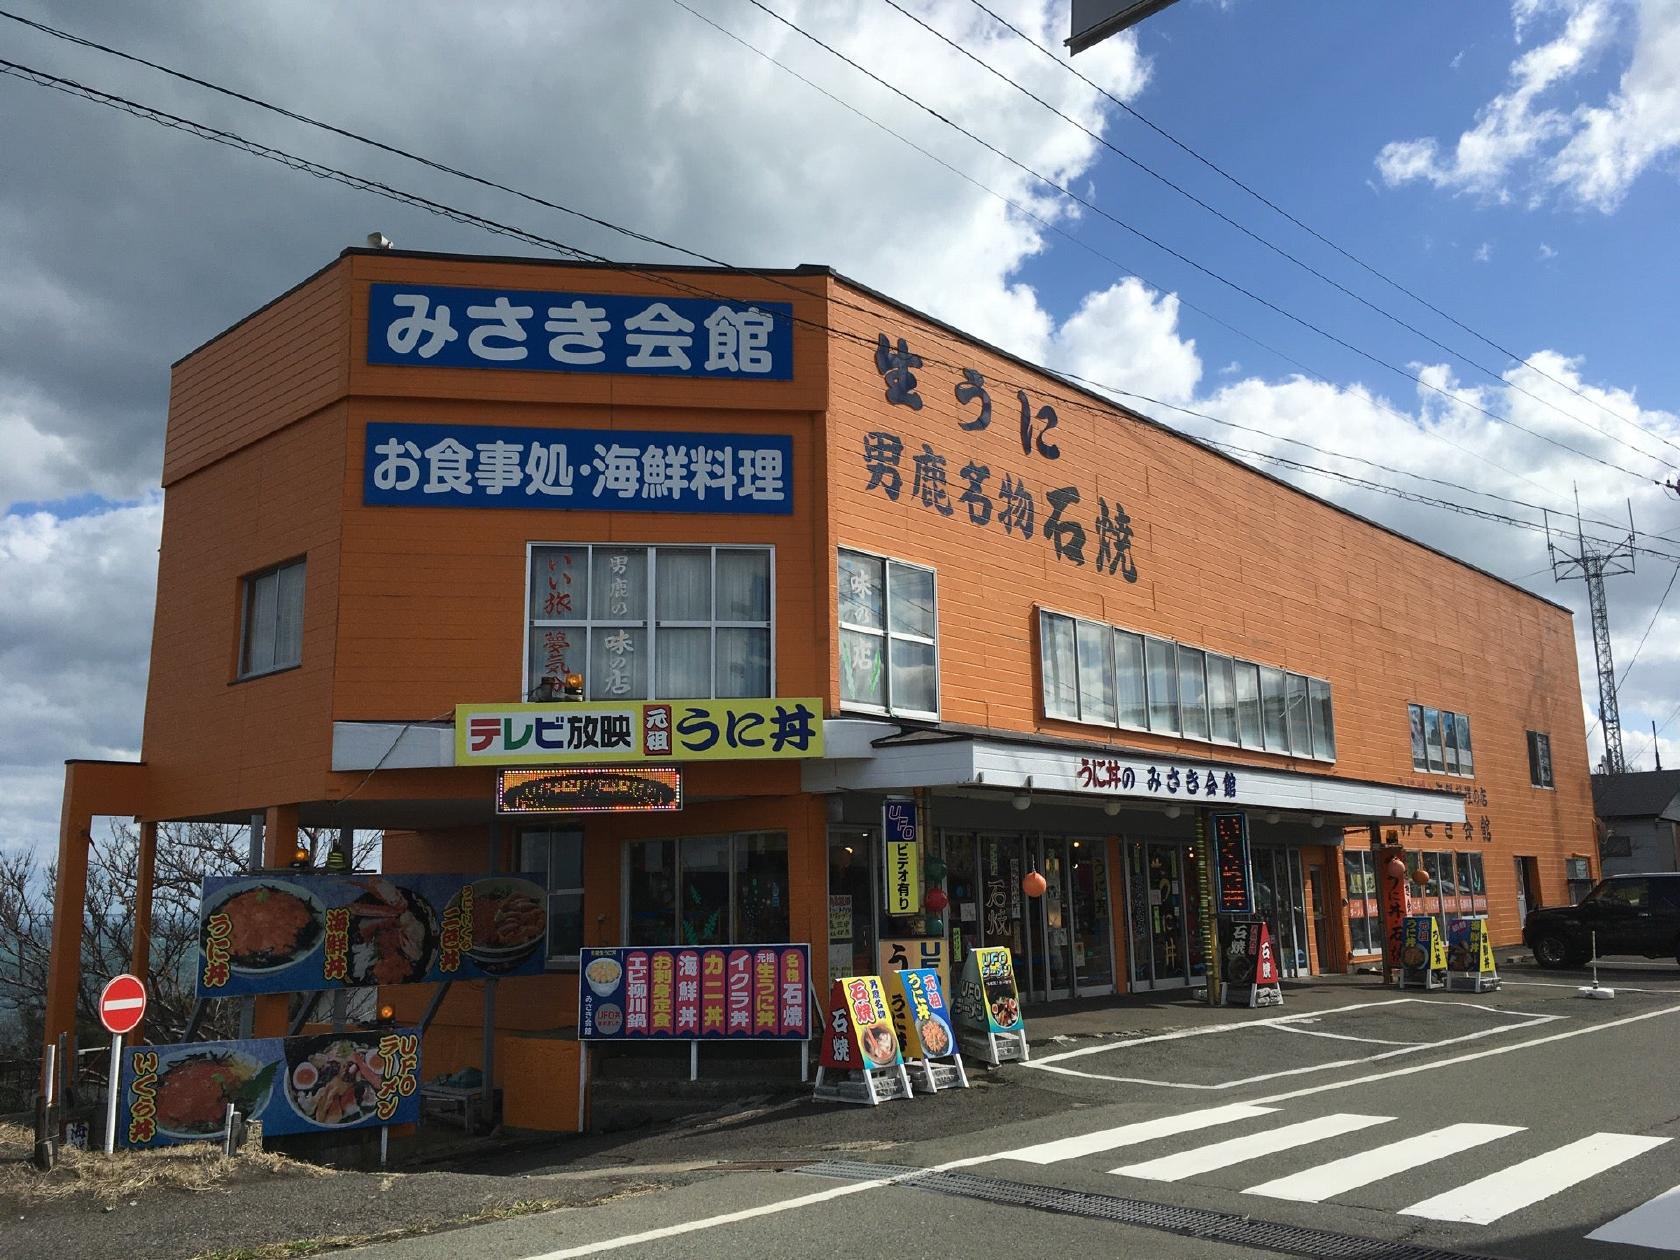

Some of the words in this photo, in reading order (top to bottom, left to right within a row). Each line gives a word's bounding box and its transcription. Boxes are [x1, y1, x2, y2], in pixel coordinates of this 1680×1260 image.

[387, 294, 773, 373] みさき会館
[874, 332, 1061, 460] 生うに
[373, 438, 785, 501] お食事処・海鮮料理
[864, 431, 1137, 584] 男鹿名物石焼
[469, 715, 632, 751] テレビ放映
[645, 709, 669, 751] 元祖
[676, 703, 816, 753] うに丼
[1077, 758, 1135, 790] うに丼の
[1147, 766, 1236, 798] みさき会館
[889, 805, 914, 840] UFO
[204, 913, 233, 987] うに丼
[982, 951, 1008, 967] UFO
[1433, 930, 1441, 964] うに丼
[628, 957, 647, 1028] エビ柳川鍋
[678, 955, 698, 1027] 海鮮丼
[704, 954, 725, 1027] カニ丼
[730, 954, 750, 1027] イクラ丼
[756, 963, 775, 1027] 生うに丼
[783, 983, 803, 1027] 石焼
[850, 980, 875, 1024] 石焼
[908, 972, 930, 1020] うに丼
[923, 974, 942, 1009] 元祖
[960, 980, 981, 1002] UFO
[832, 1008, 849, 1061] 石焼
[376, 1035, 401, 1120] ラーメン
[399, 1034, 419, 1097] UFO
